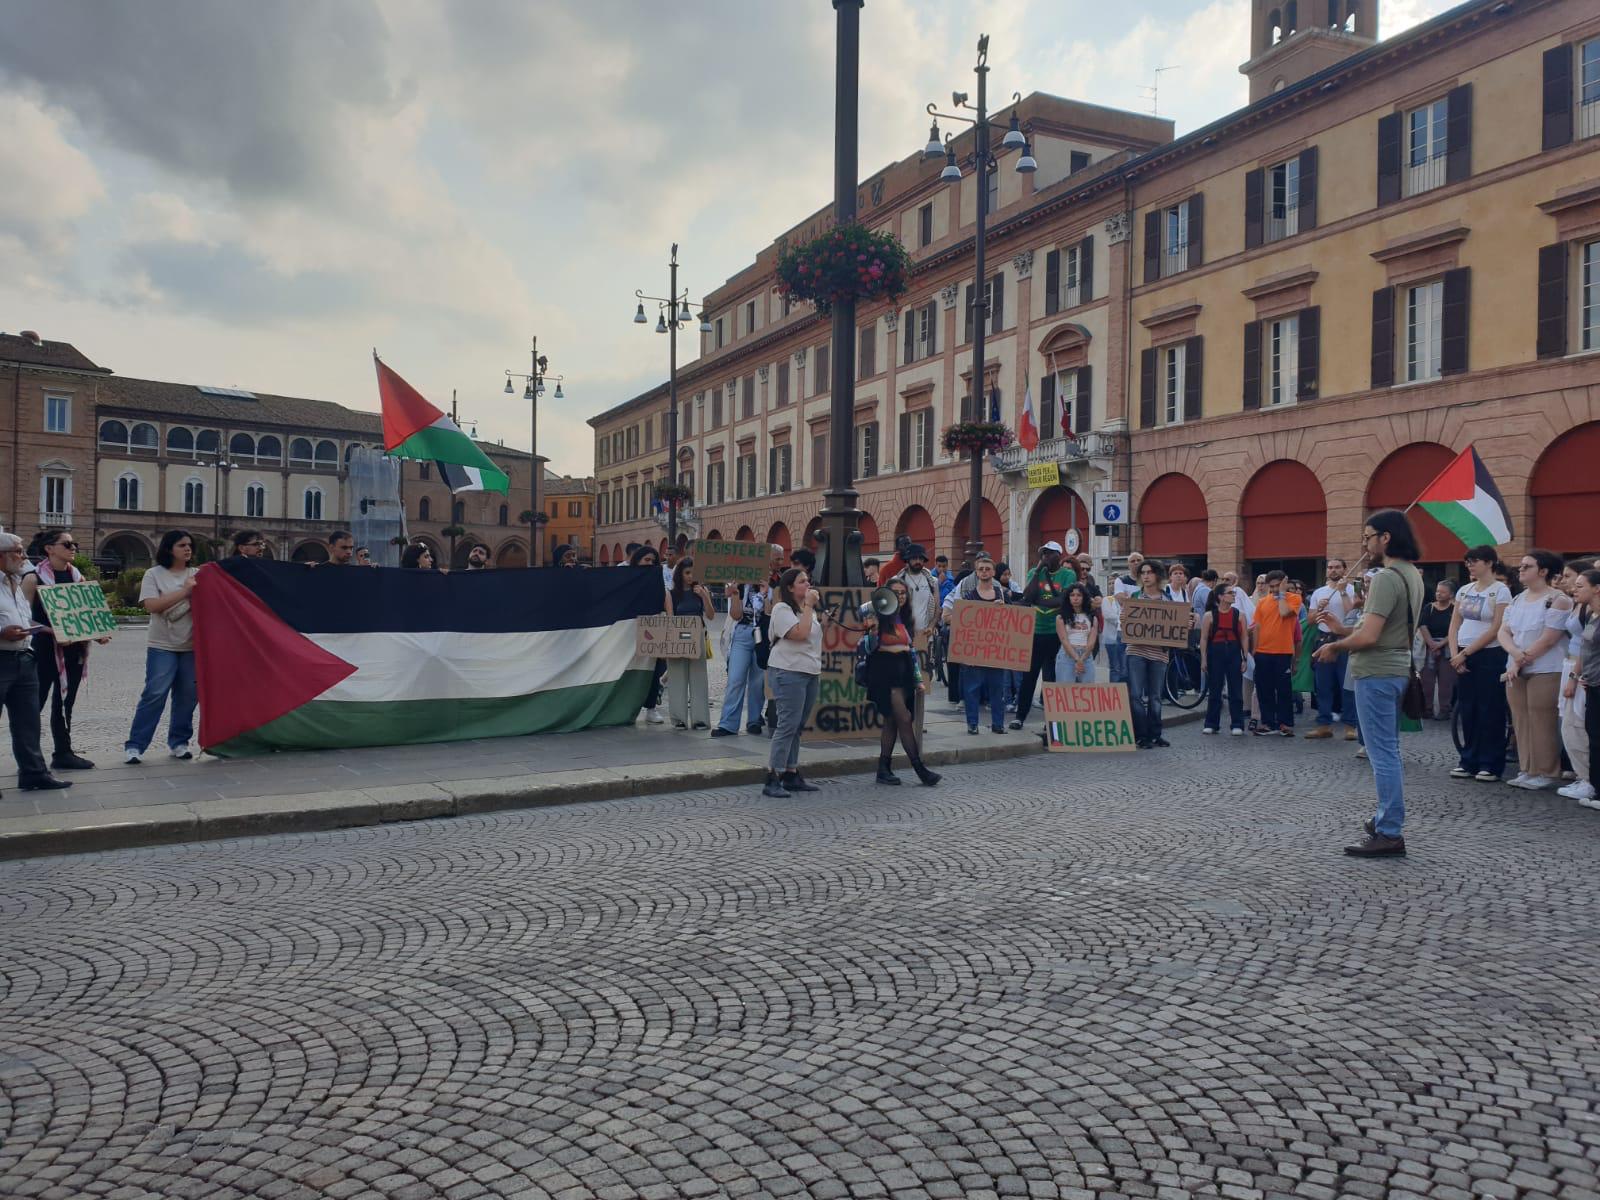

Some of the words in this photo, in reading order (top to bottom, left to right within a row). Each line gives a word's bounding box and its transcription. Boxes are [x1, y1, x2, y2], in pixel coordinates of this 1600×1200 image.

[696, 541, 765, 558] RESISTERE
[704, 565, 763, 581] ESISTERE
[960, 605, 1034, 636] GOVERNO
[1127, 606, 1178, 621] ZATTINI
[955, 628, 1012, 645] MELONI
[1125, 622, 1188, 641] COMPLICE
[951, 641, 1030, 664] COMPLICE
[1044, 686, 1123, 713] PALESTINA
[1063, 720, 1134, 747] LIBERA
